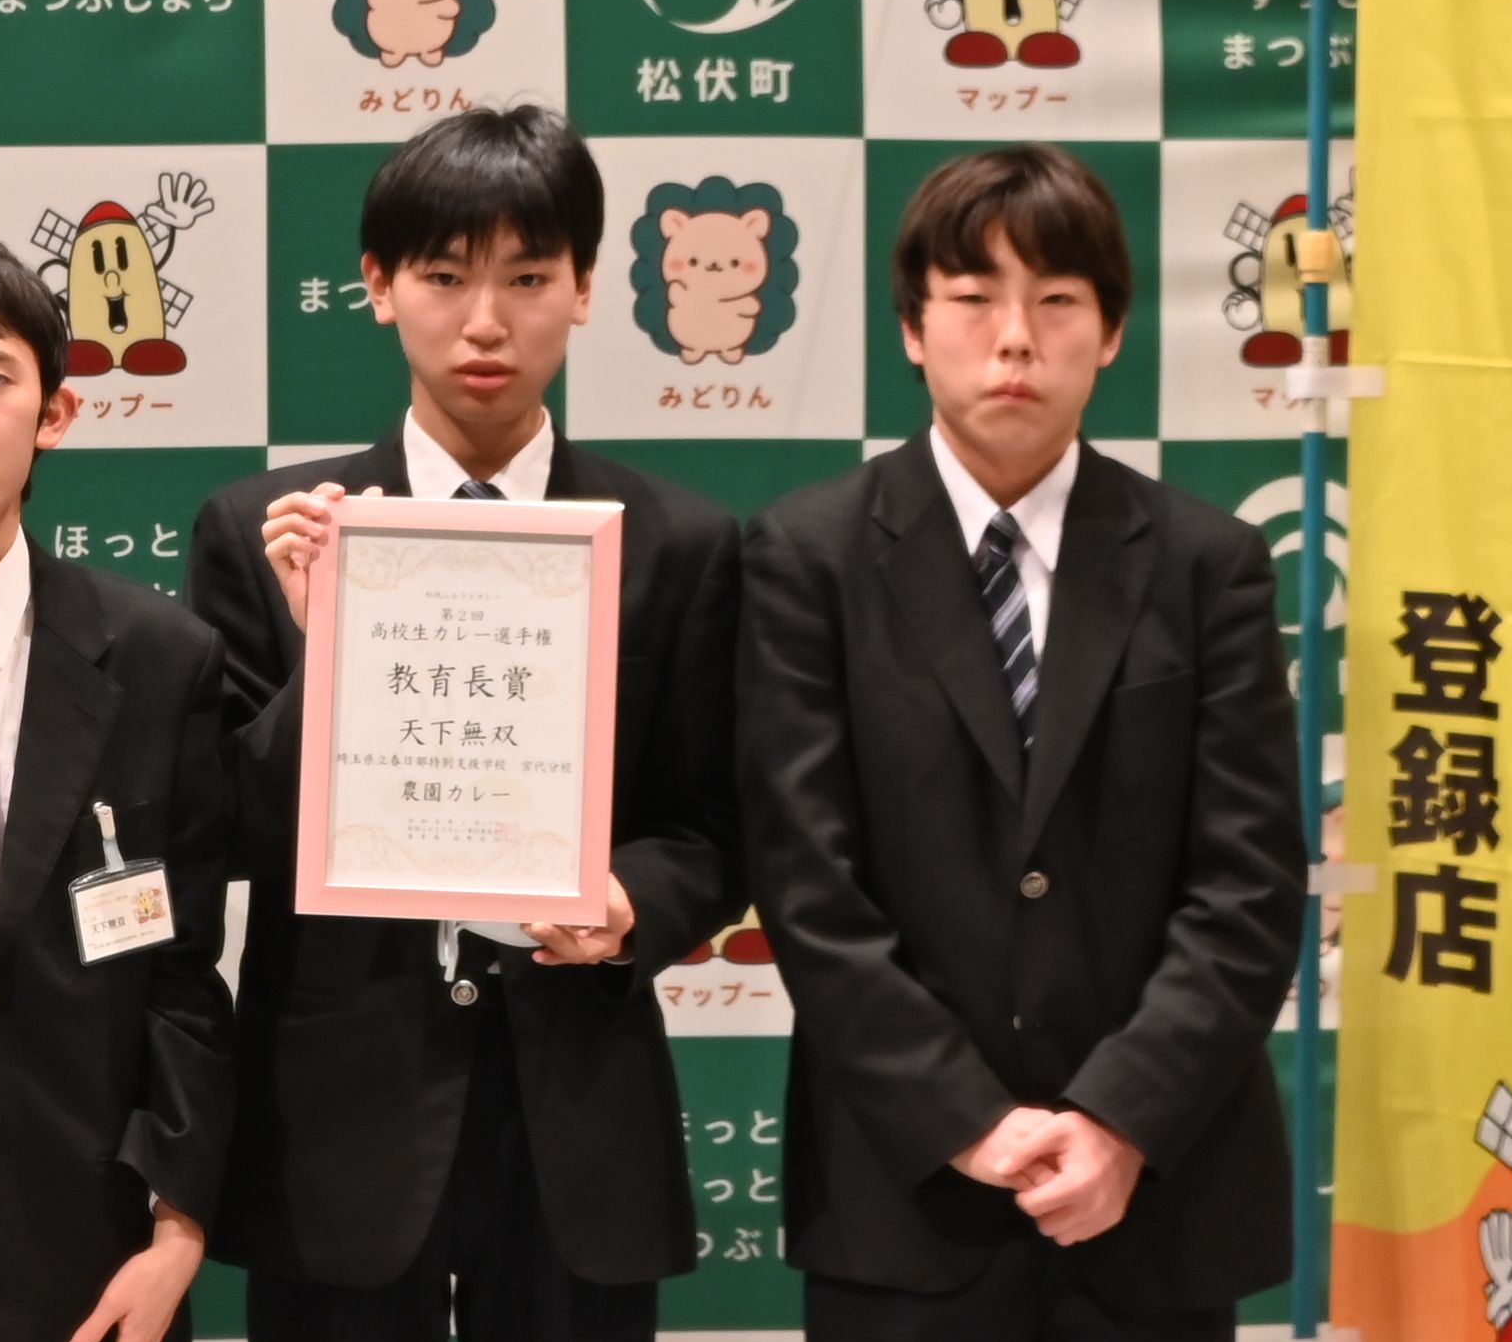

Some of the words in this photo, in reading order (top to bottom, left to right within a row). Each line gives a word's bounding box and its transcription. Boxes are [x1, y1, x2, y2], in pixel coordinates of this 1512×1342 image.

[635, 57, 795, 104] 松伏町
[358, 87, 474, 113] みどりん
[957, 85, 1069, 112] マップー
[657, 384, 772, 411] みどりん
[53, 522, 180, 559] ほっと
[369, 620, 553, 648] 高校生カレー選手権
[387, 662, 534, 702] 教育長賞
[399, 718, 519, 748] 天下無双
[400, 779, 511, 804] 農園カレー
[1384, 589, 1504, 995] 登録店
[661, 981, 772, 1007] マップー
[681, 1110, 781, 1146] っと
[688, 1168, 779, 1203] っと
